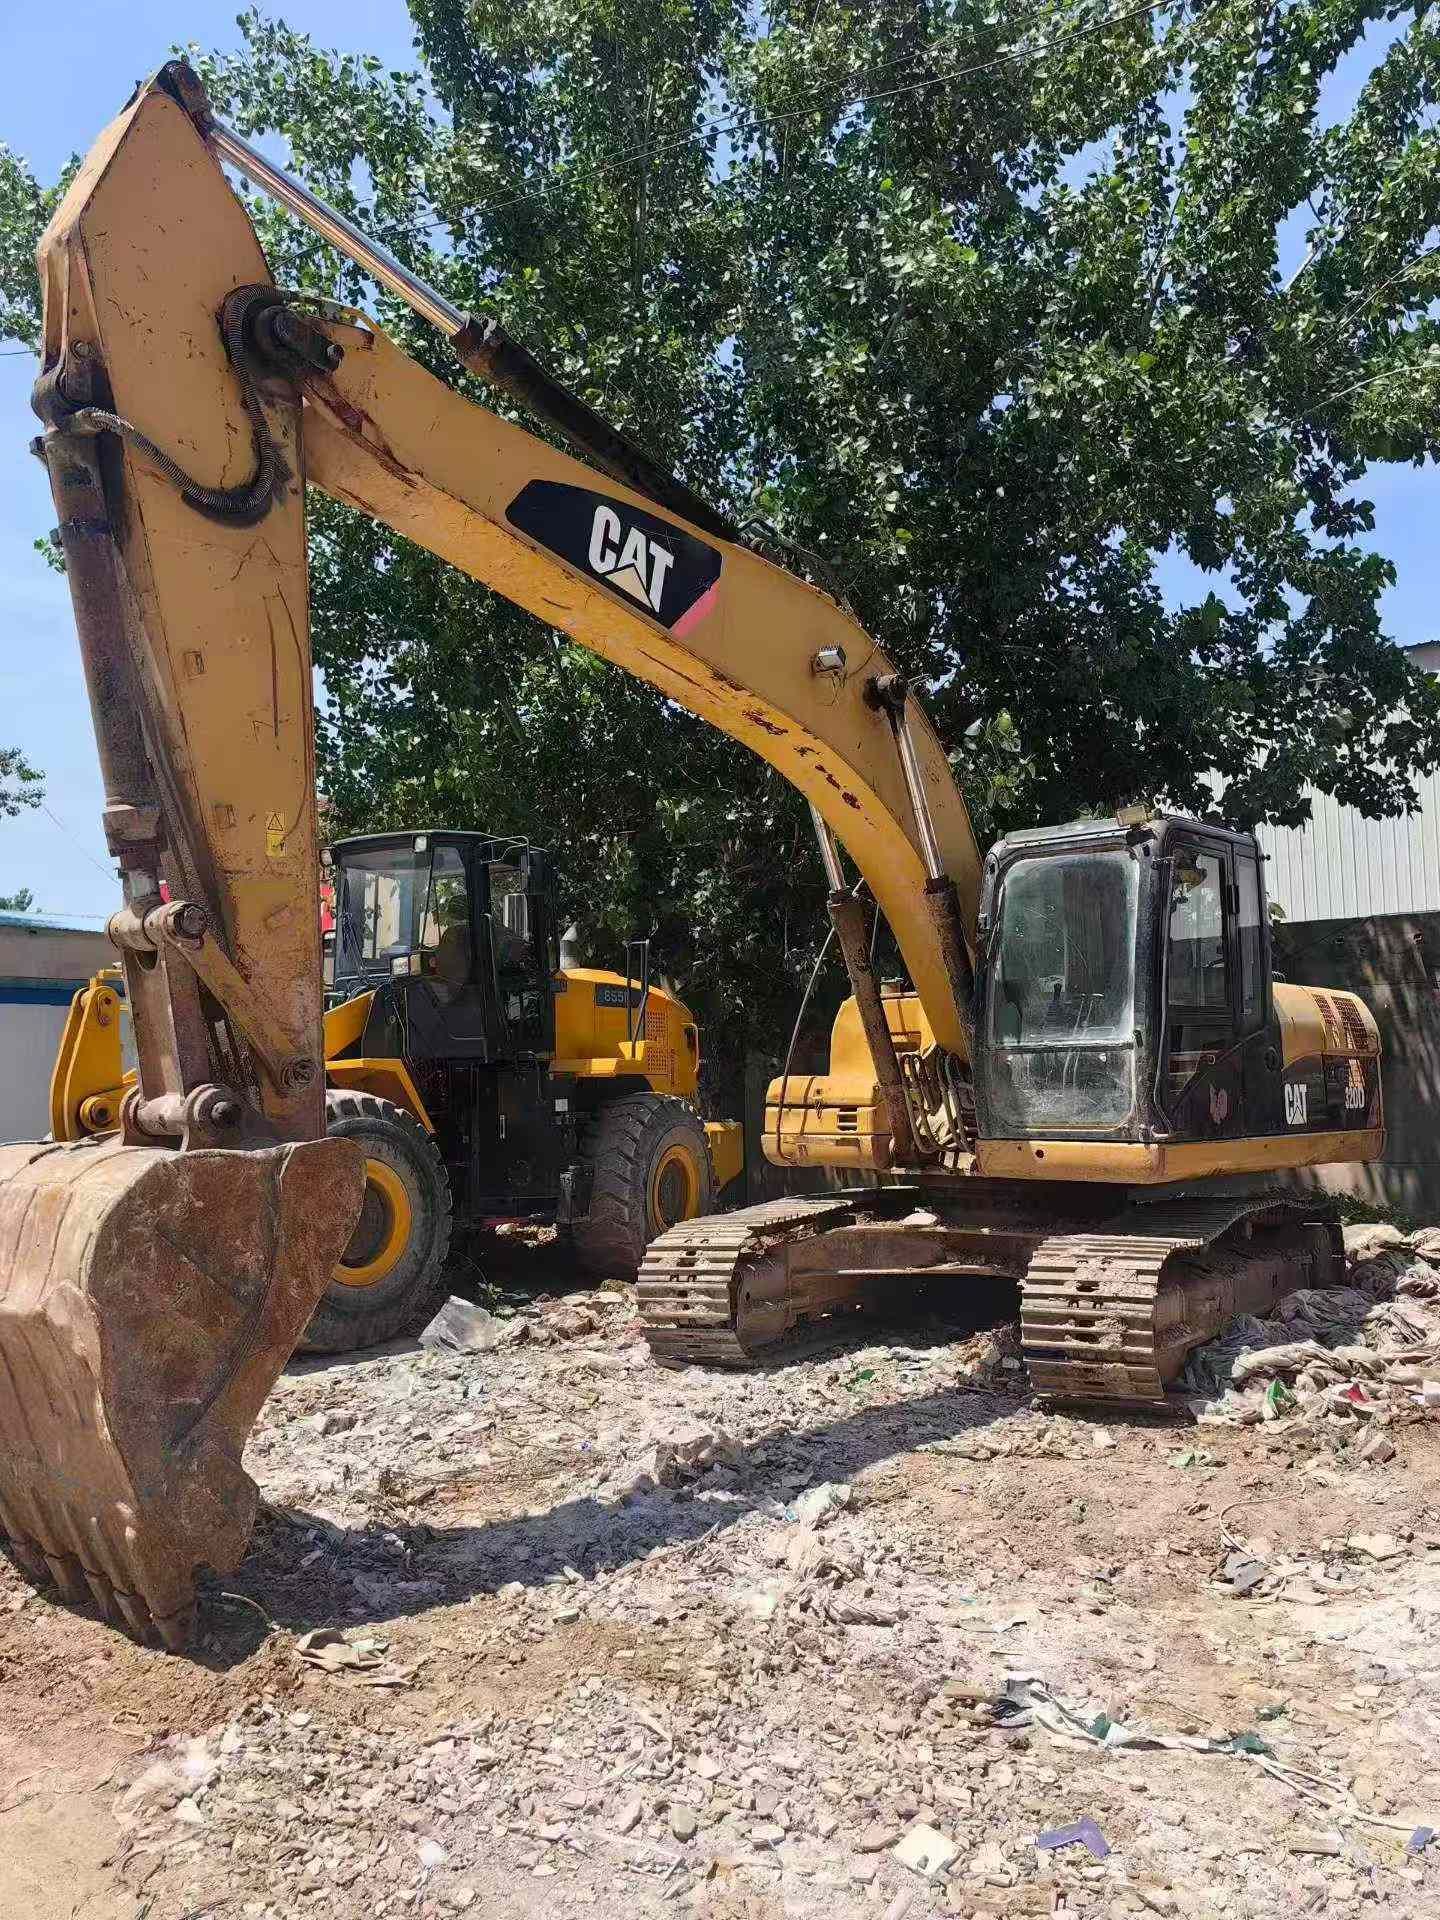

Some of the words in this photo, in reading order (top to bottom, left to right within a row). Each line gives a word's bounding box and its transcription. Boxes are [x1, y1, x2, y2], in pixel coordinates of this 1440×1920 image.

[588, 505, 675, 613] CAT
[1284, 1083, 1307, 1125] CAT
[1344, 1086, 1365, 1109] 320D
